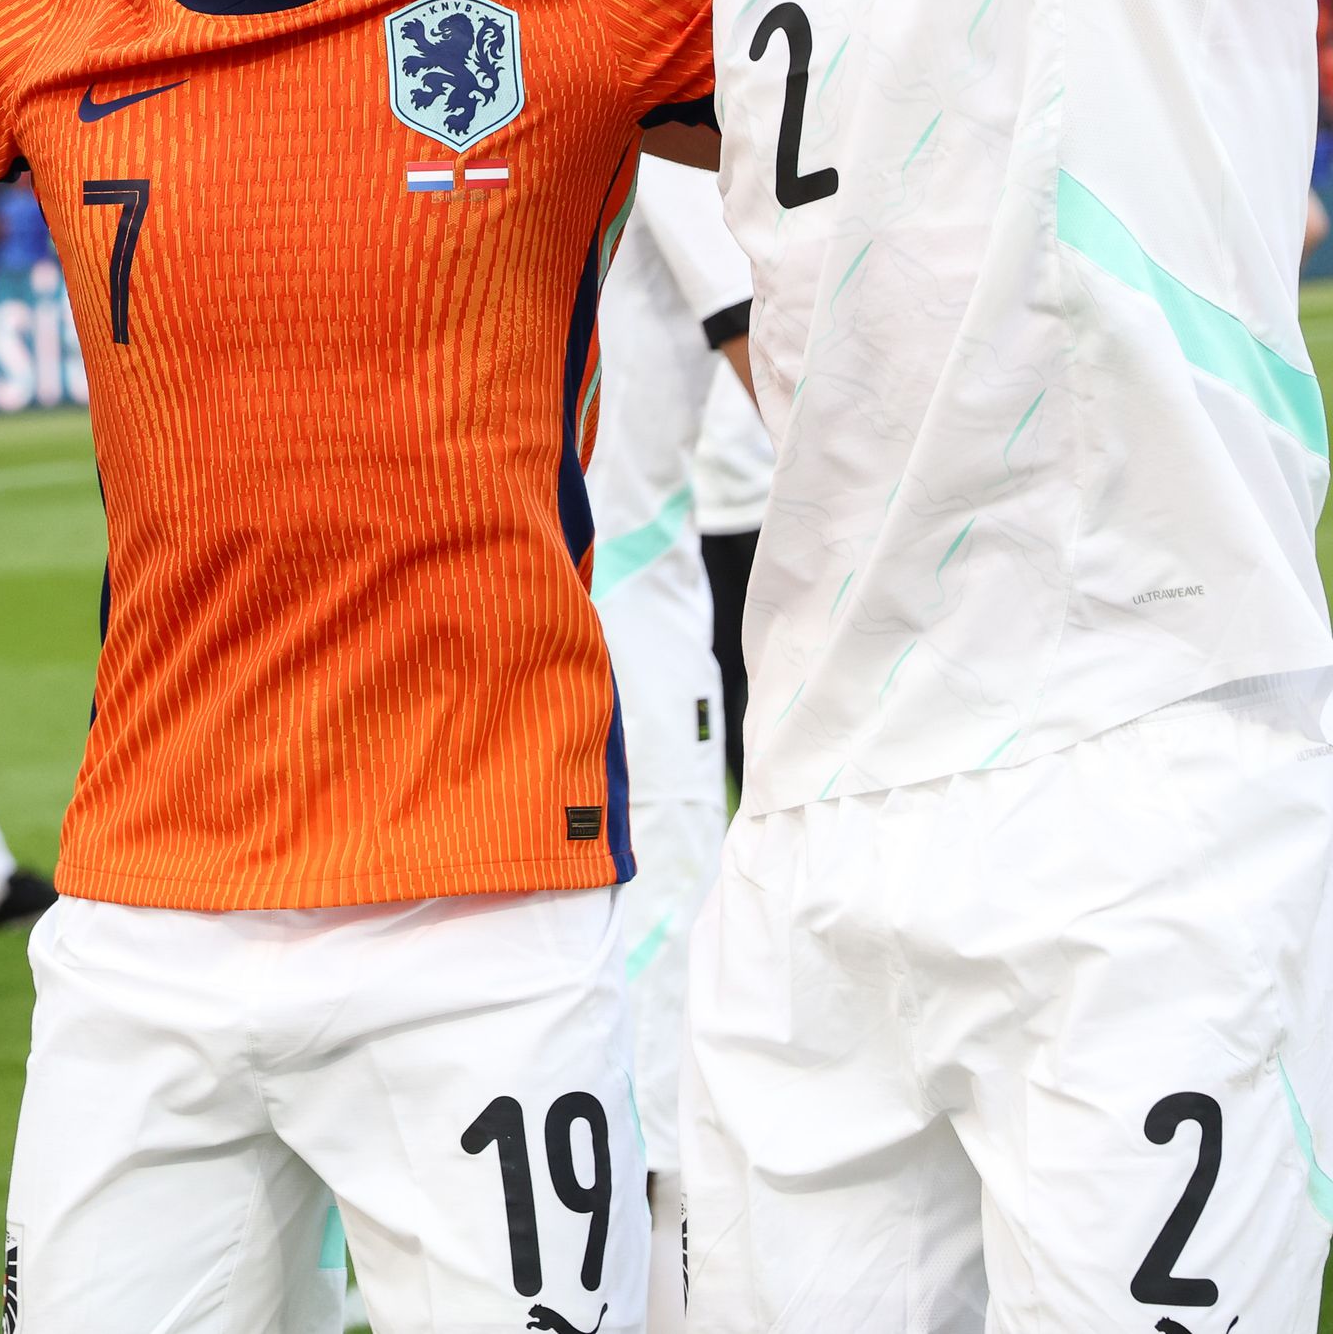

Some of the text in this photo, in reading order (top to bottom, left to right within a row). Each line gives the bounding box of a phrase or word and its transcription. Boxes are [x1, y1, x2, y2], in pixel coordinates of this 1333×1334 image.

[429, 1, 474, 15] KNVB
[748, 1, 839, 210] 2
[82, 179, 151, 345] 7
[1132, 585, 1206, 605] ULTRAWEAVE
[460, 1090, 612, 1298] 19
[1130, 1091, 1223, 1308] 2
